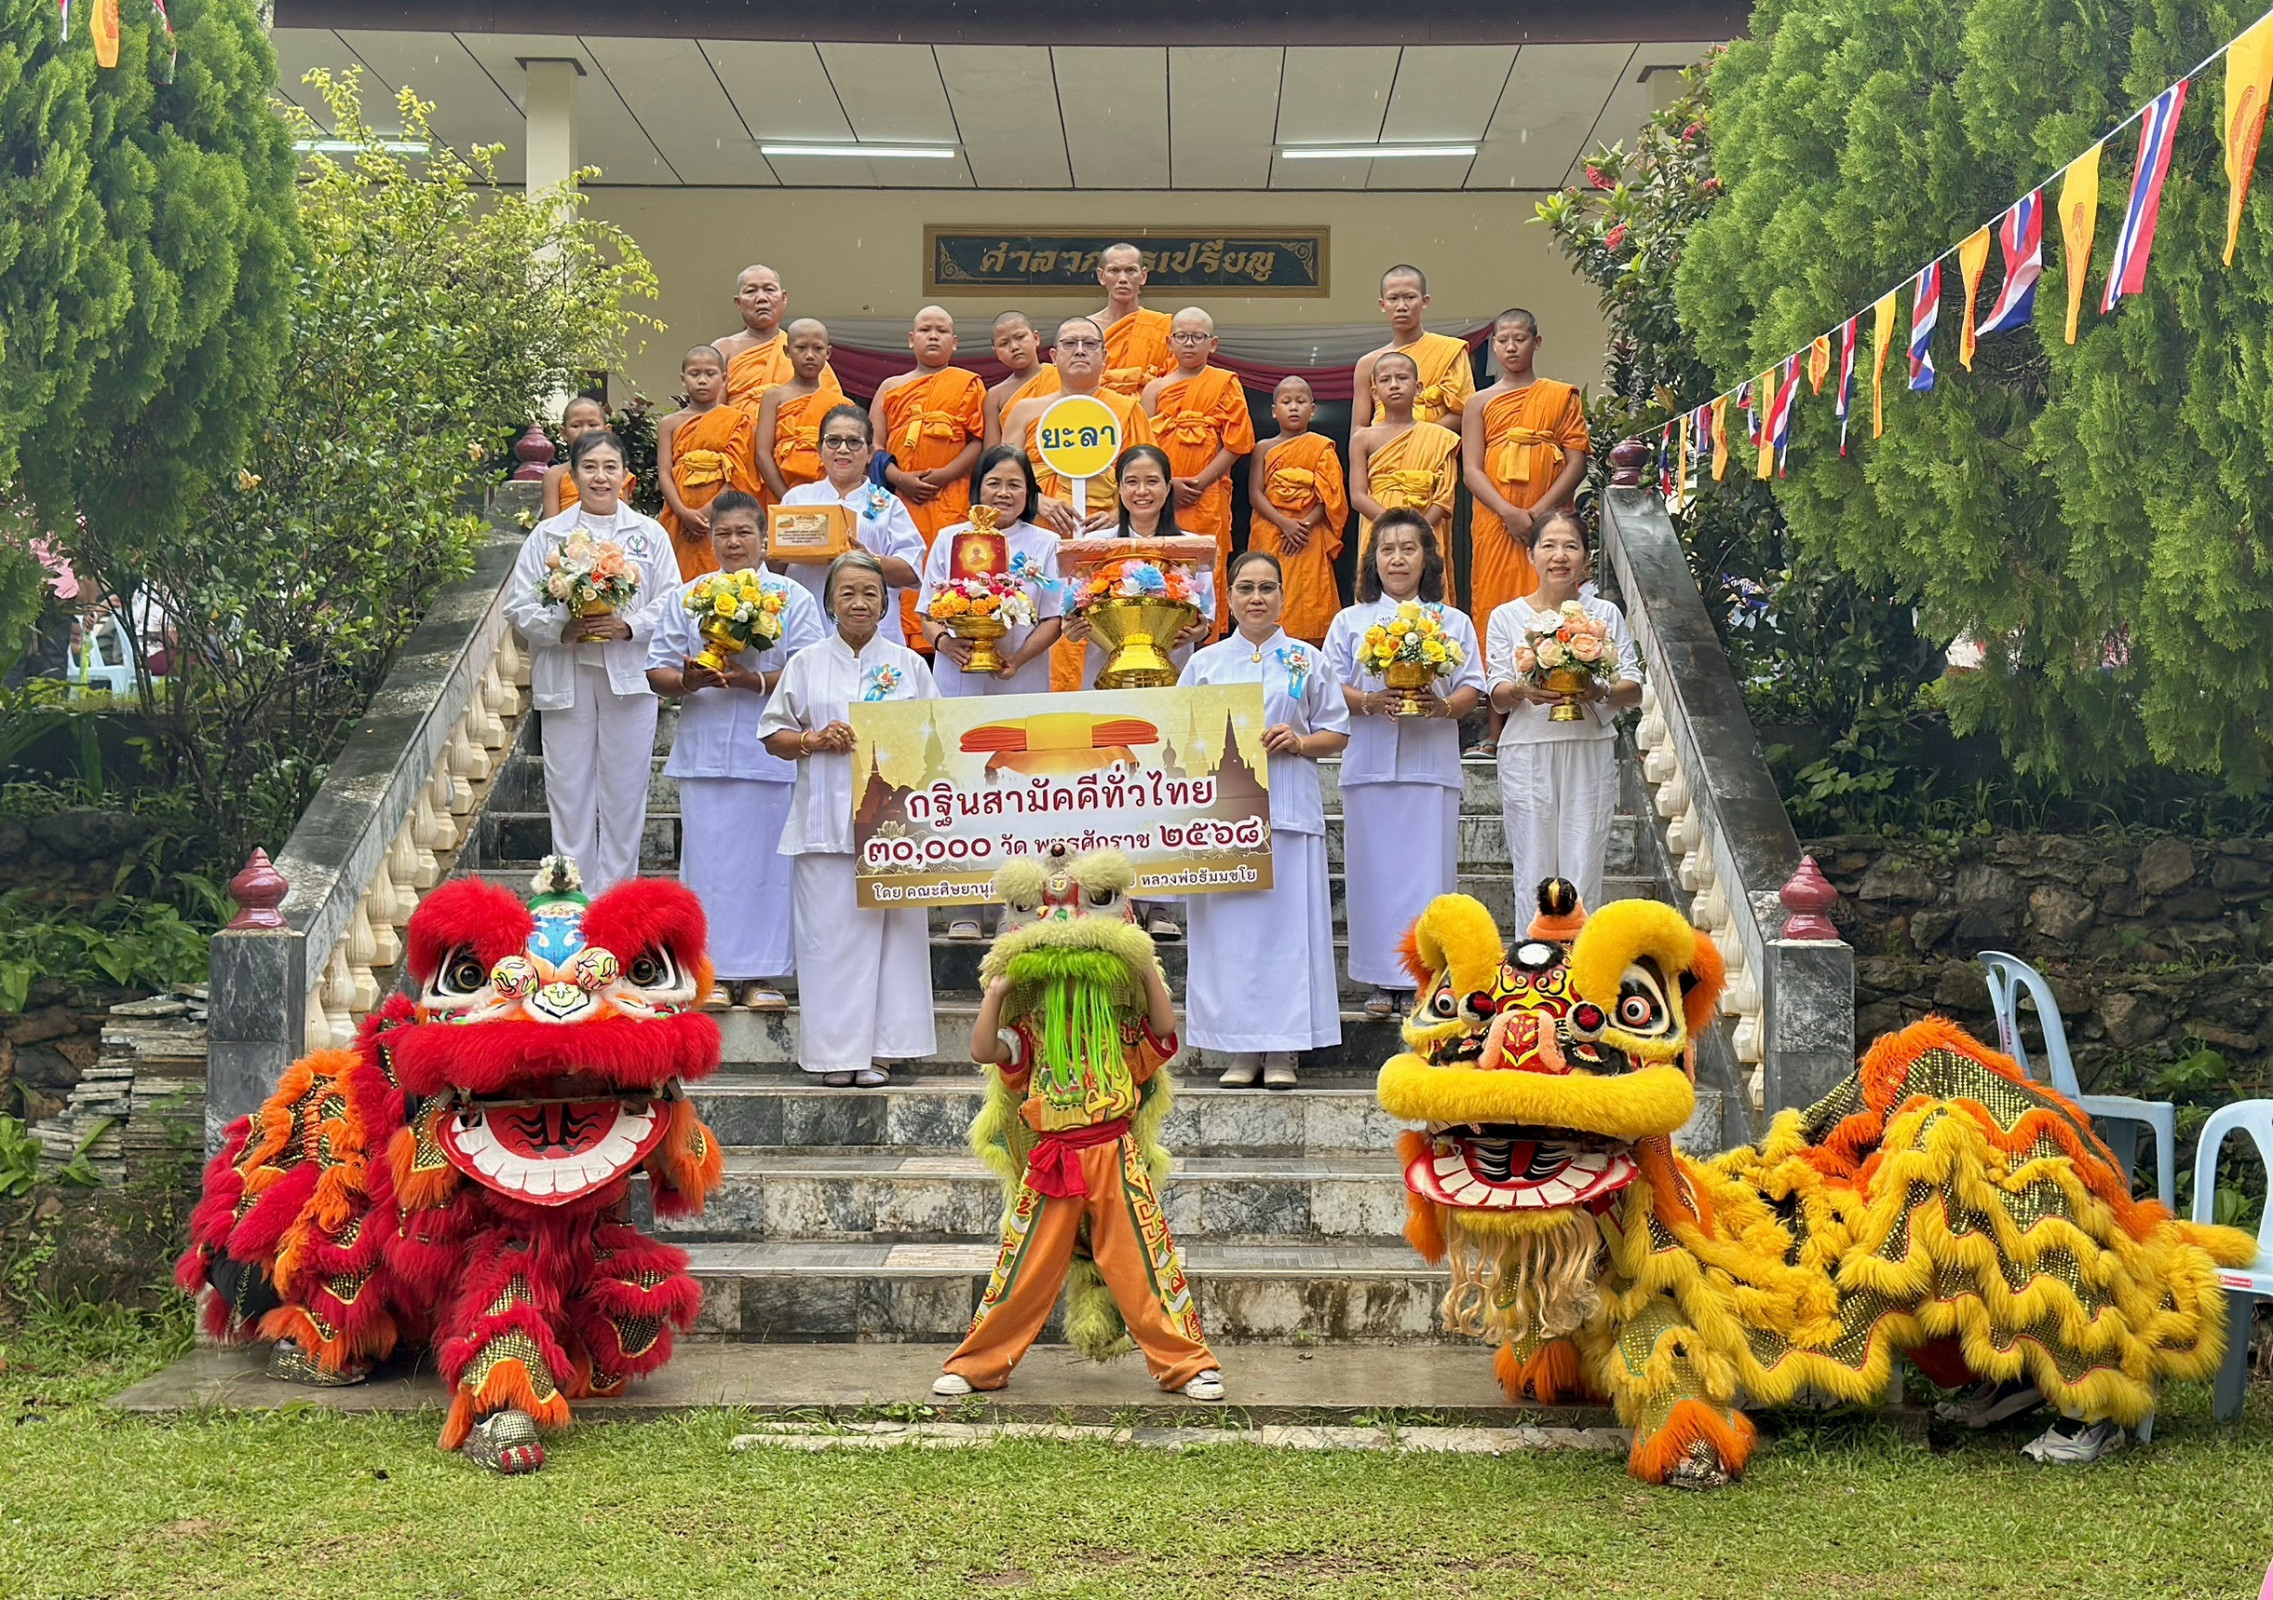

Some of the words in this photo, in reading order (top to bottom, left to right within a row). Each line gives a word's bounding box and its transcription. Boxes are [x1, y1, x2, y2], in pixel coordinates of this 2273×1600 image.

[979, 239, 1276, 282] ศาลากรเปรียญ
[1041, 425, 1117, 450] ยะลา
[909, 763, 1214, 828] กฐินสามัคคีทั่วไทย
[868, 837, 992, 866] ๓๐,๐๐๐
[1000, 833, 1028, 856] วัด
[1159, 820, 1260, 848] ๒๕๖๘
[873, 884, 902, 899] โดย
